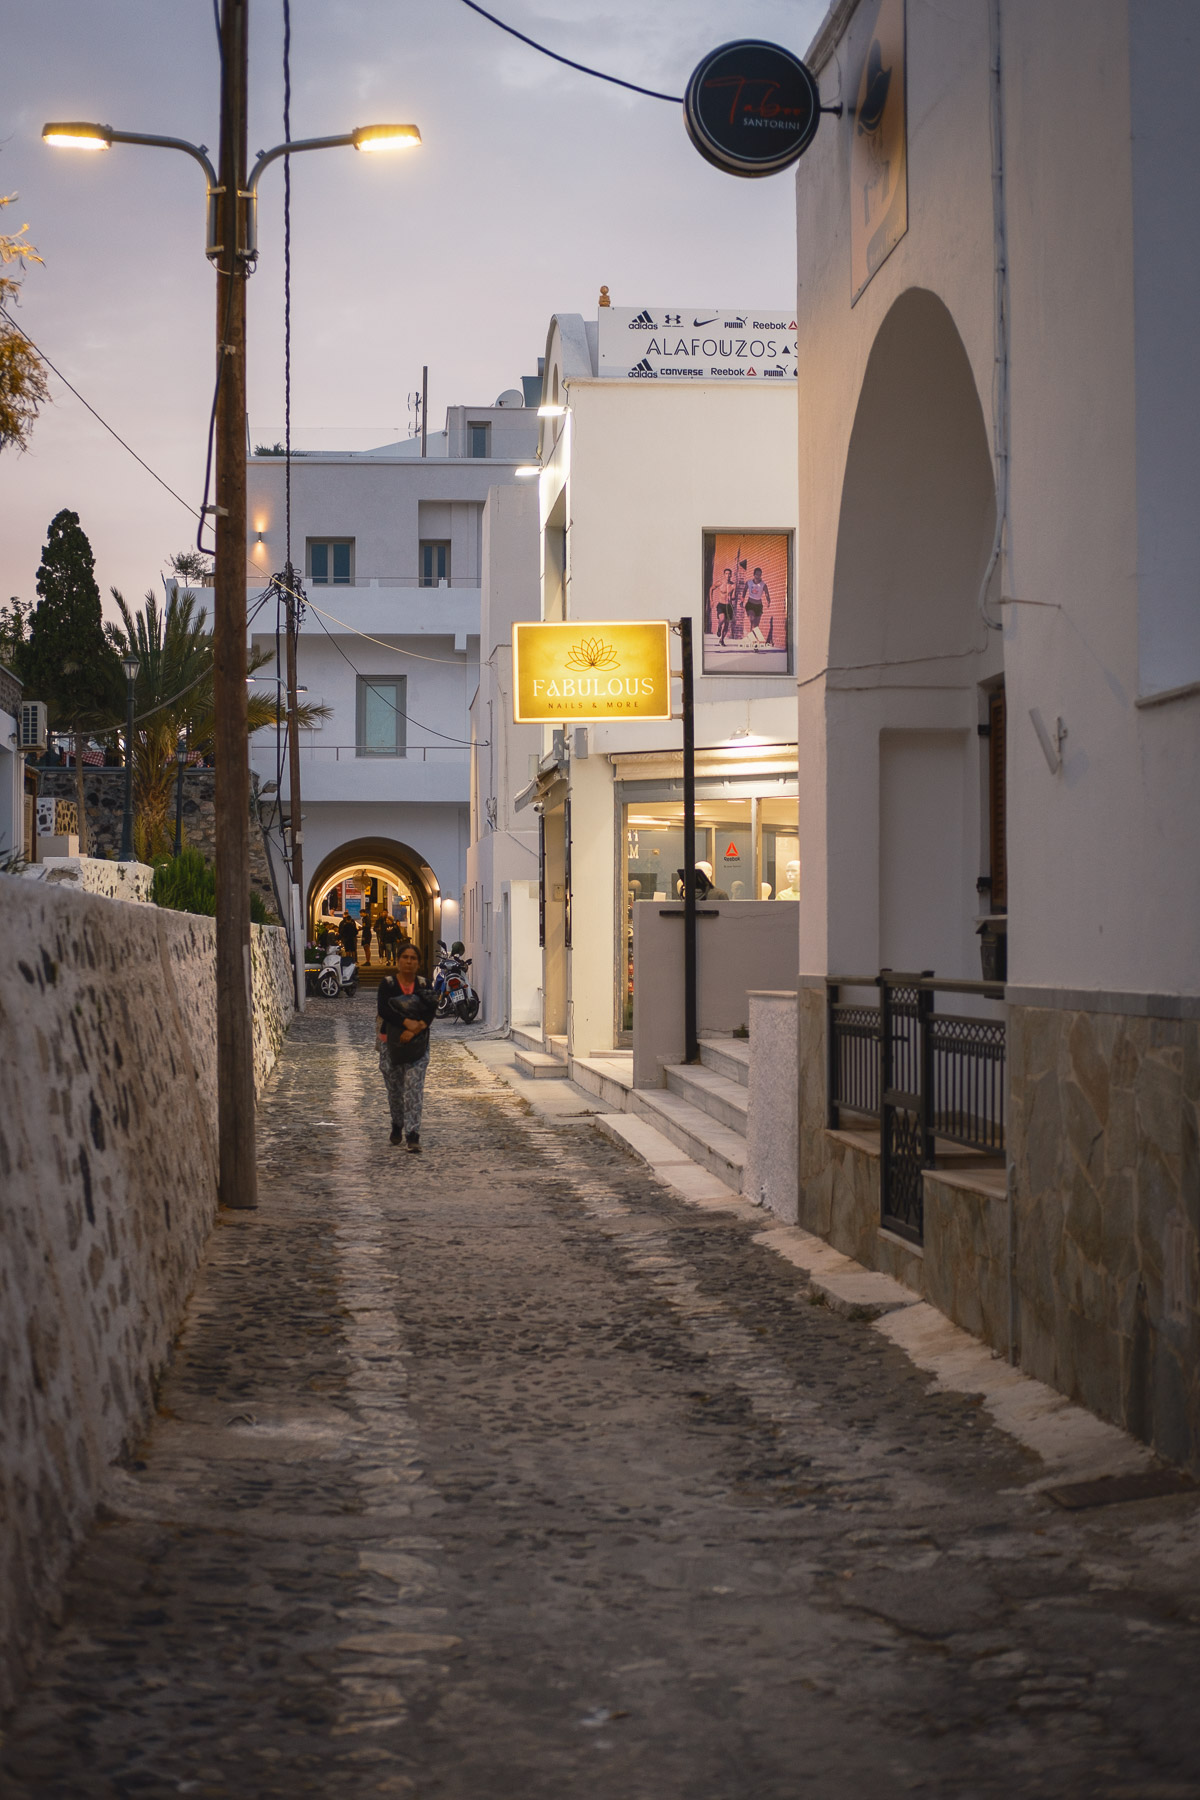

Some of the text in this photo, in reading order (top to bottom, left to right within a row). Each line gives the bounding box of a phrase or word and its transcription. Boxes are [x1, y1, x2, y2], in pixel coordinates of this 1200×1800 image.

[743, 117, 800, 130] SANTORINI
[628, 321, 787, 330] adidas PUMA Reebok
[646, 338, 777, 358] ALAFOUZOS
[628, 367, 784, 378] adidas CONVERSE Reebok PUMA
[533, 677, 654, 697] FABULOUS
